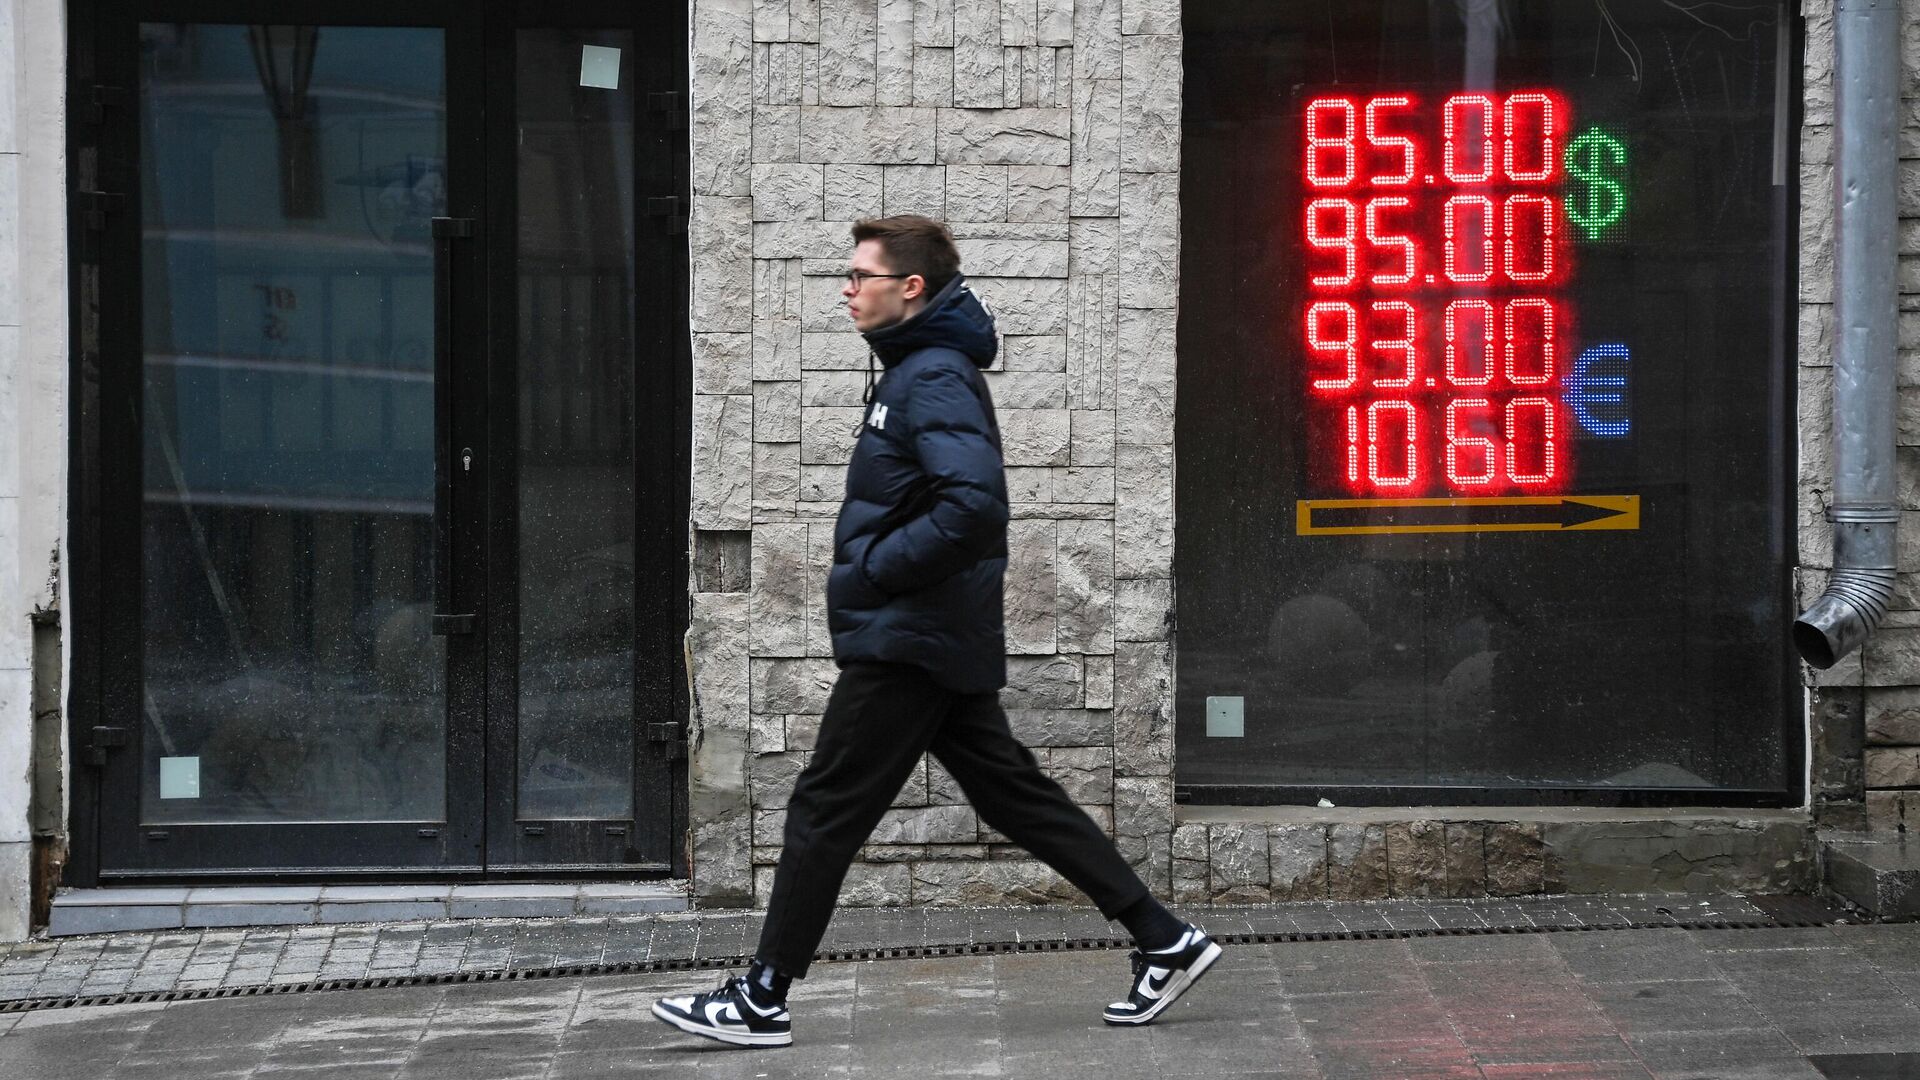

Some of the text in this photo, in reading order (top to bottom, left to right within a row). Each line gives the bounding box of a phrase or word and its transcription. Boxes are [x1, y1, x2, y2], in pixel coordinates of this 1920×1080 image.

[1306, 93, 1553, 186] 85.00
[1563, 126, 1627, 241] $
[1306, 194, 1554, 286] 95.00
[1307, 298, 1554, 389] 93.00
[1561, 343, 1630, 436] €
